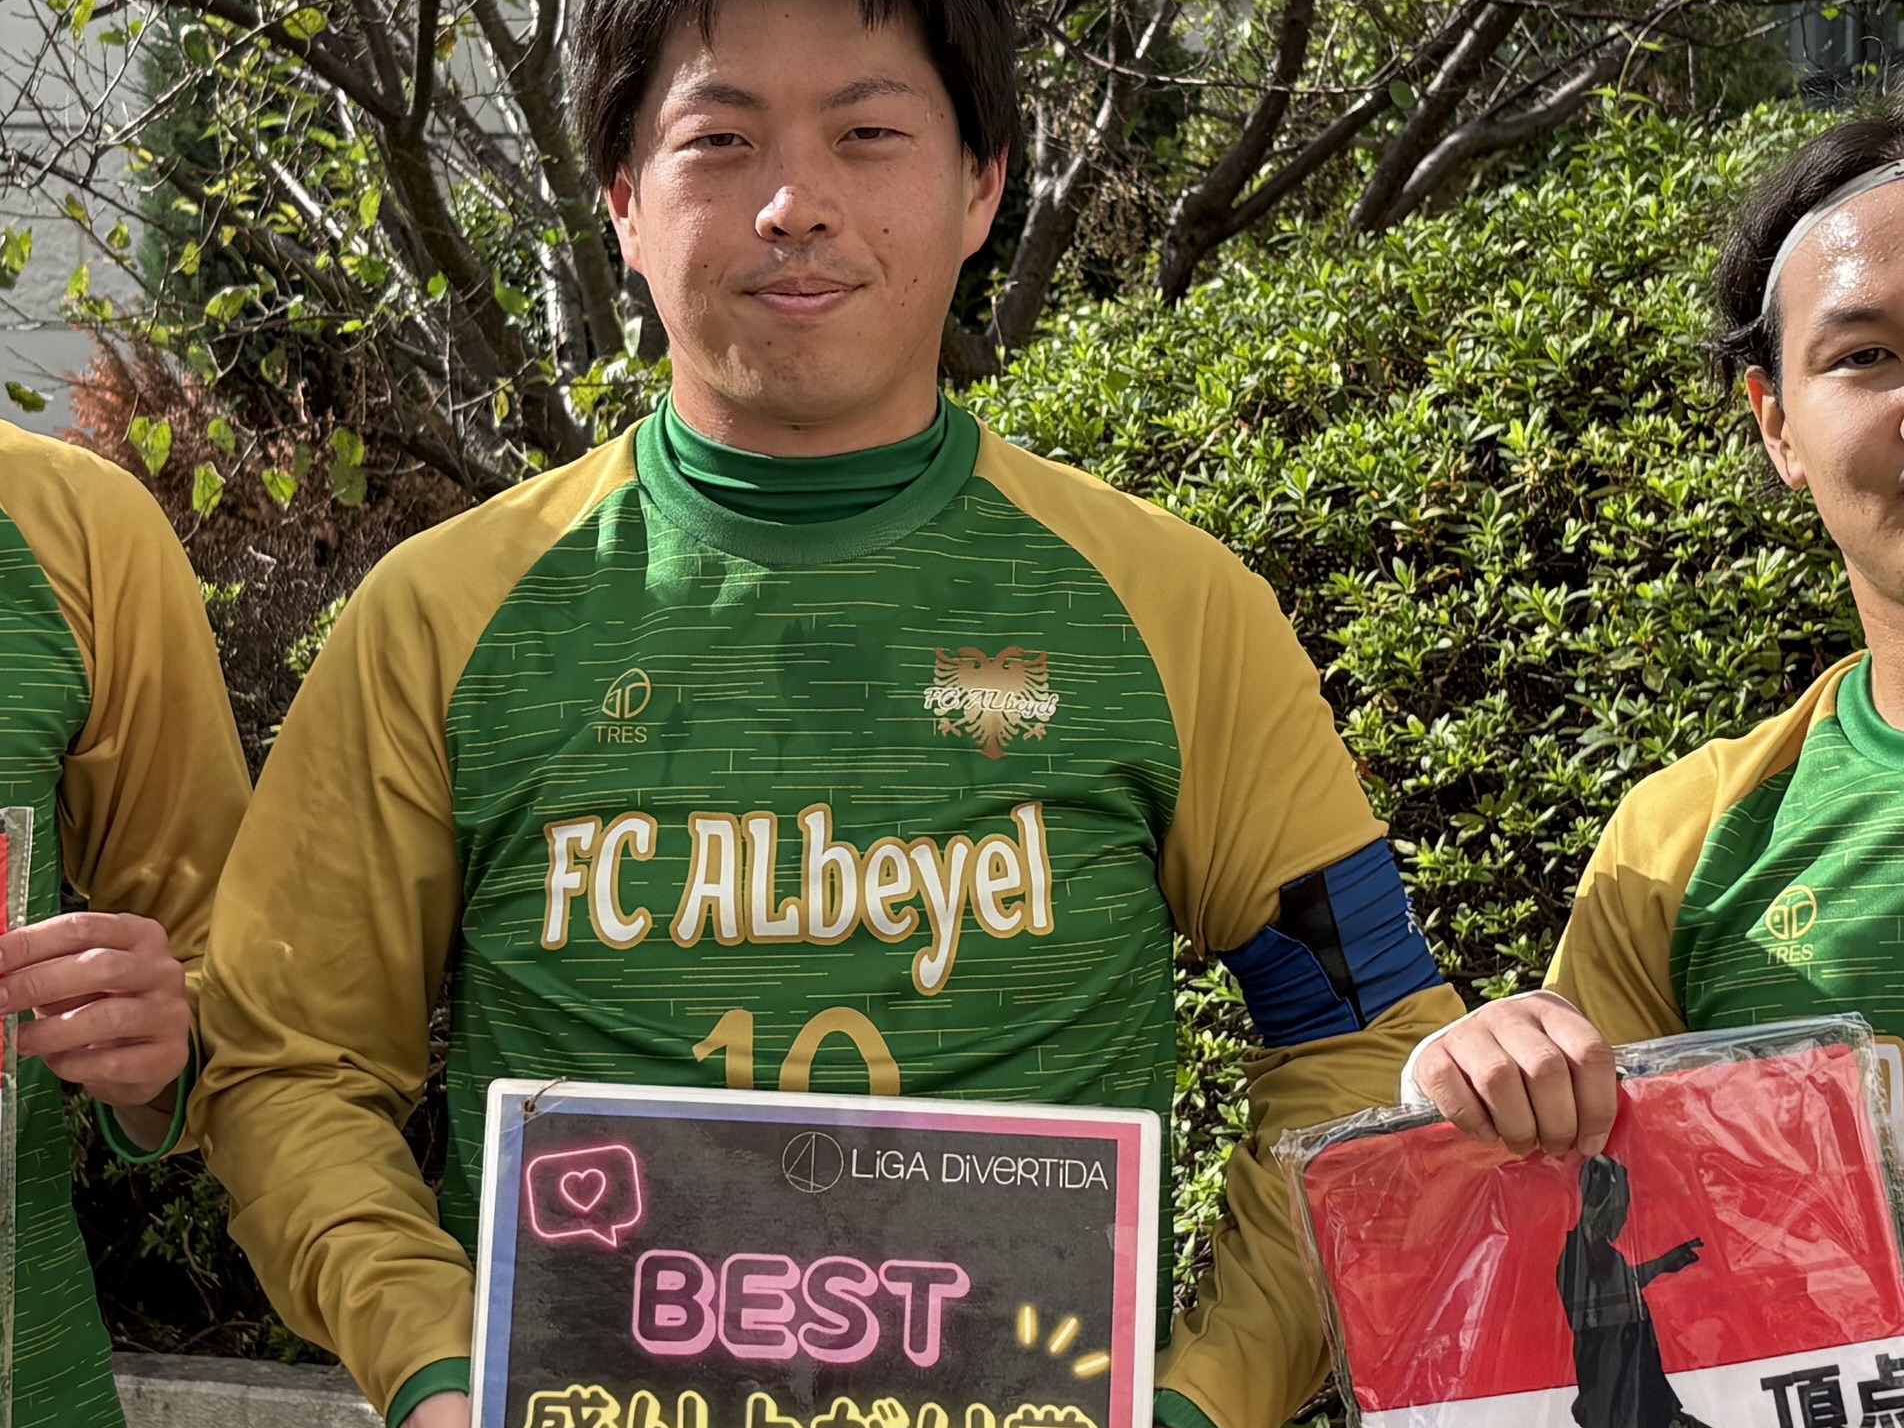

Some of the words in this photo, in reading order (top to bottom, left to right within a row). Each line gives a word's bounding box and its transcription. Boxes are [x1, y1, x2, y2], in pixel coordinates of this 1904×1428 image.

[593, 725, 648, 744] TRES
[542, 811, 658, 950] FC
[670, 802, 1054, 996] ALbeyel
[1765, 943, 1815, 965] TRES
[851, 1148, 930, 1182] LiGA
[632, 1249, 970, 1368] BEST
